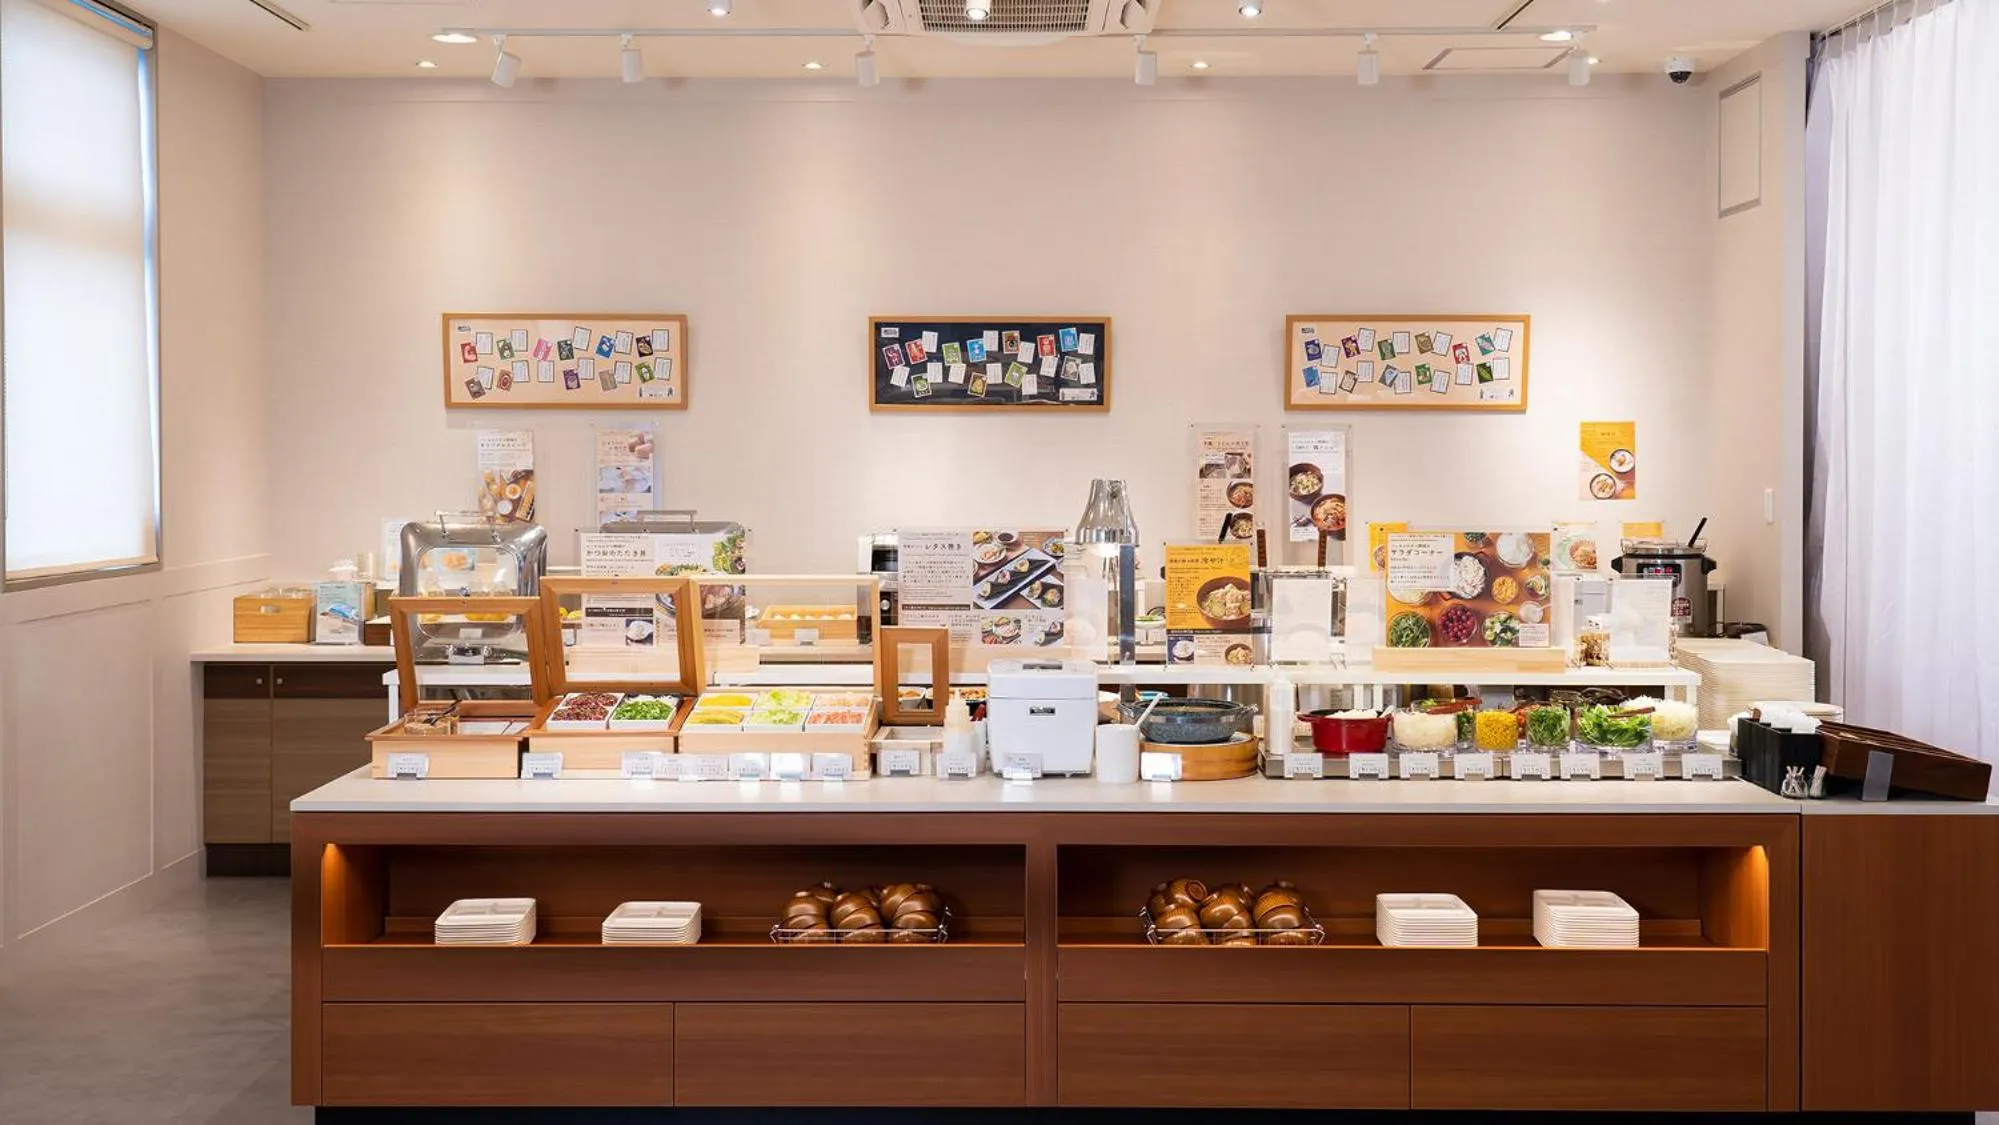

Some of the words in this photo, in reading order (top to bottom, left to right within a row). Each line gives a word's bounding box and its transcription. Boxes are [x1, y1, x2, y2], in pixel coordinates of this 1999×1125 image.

[1390, 549, 1444, 557] サラダコーナー
